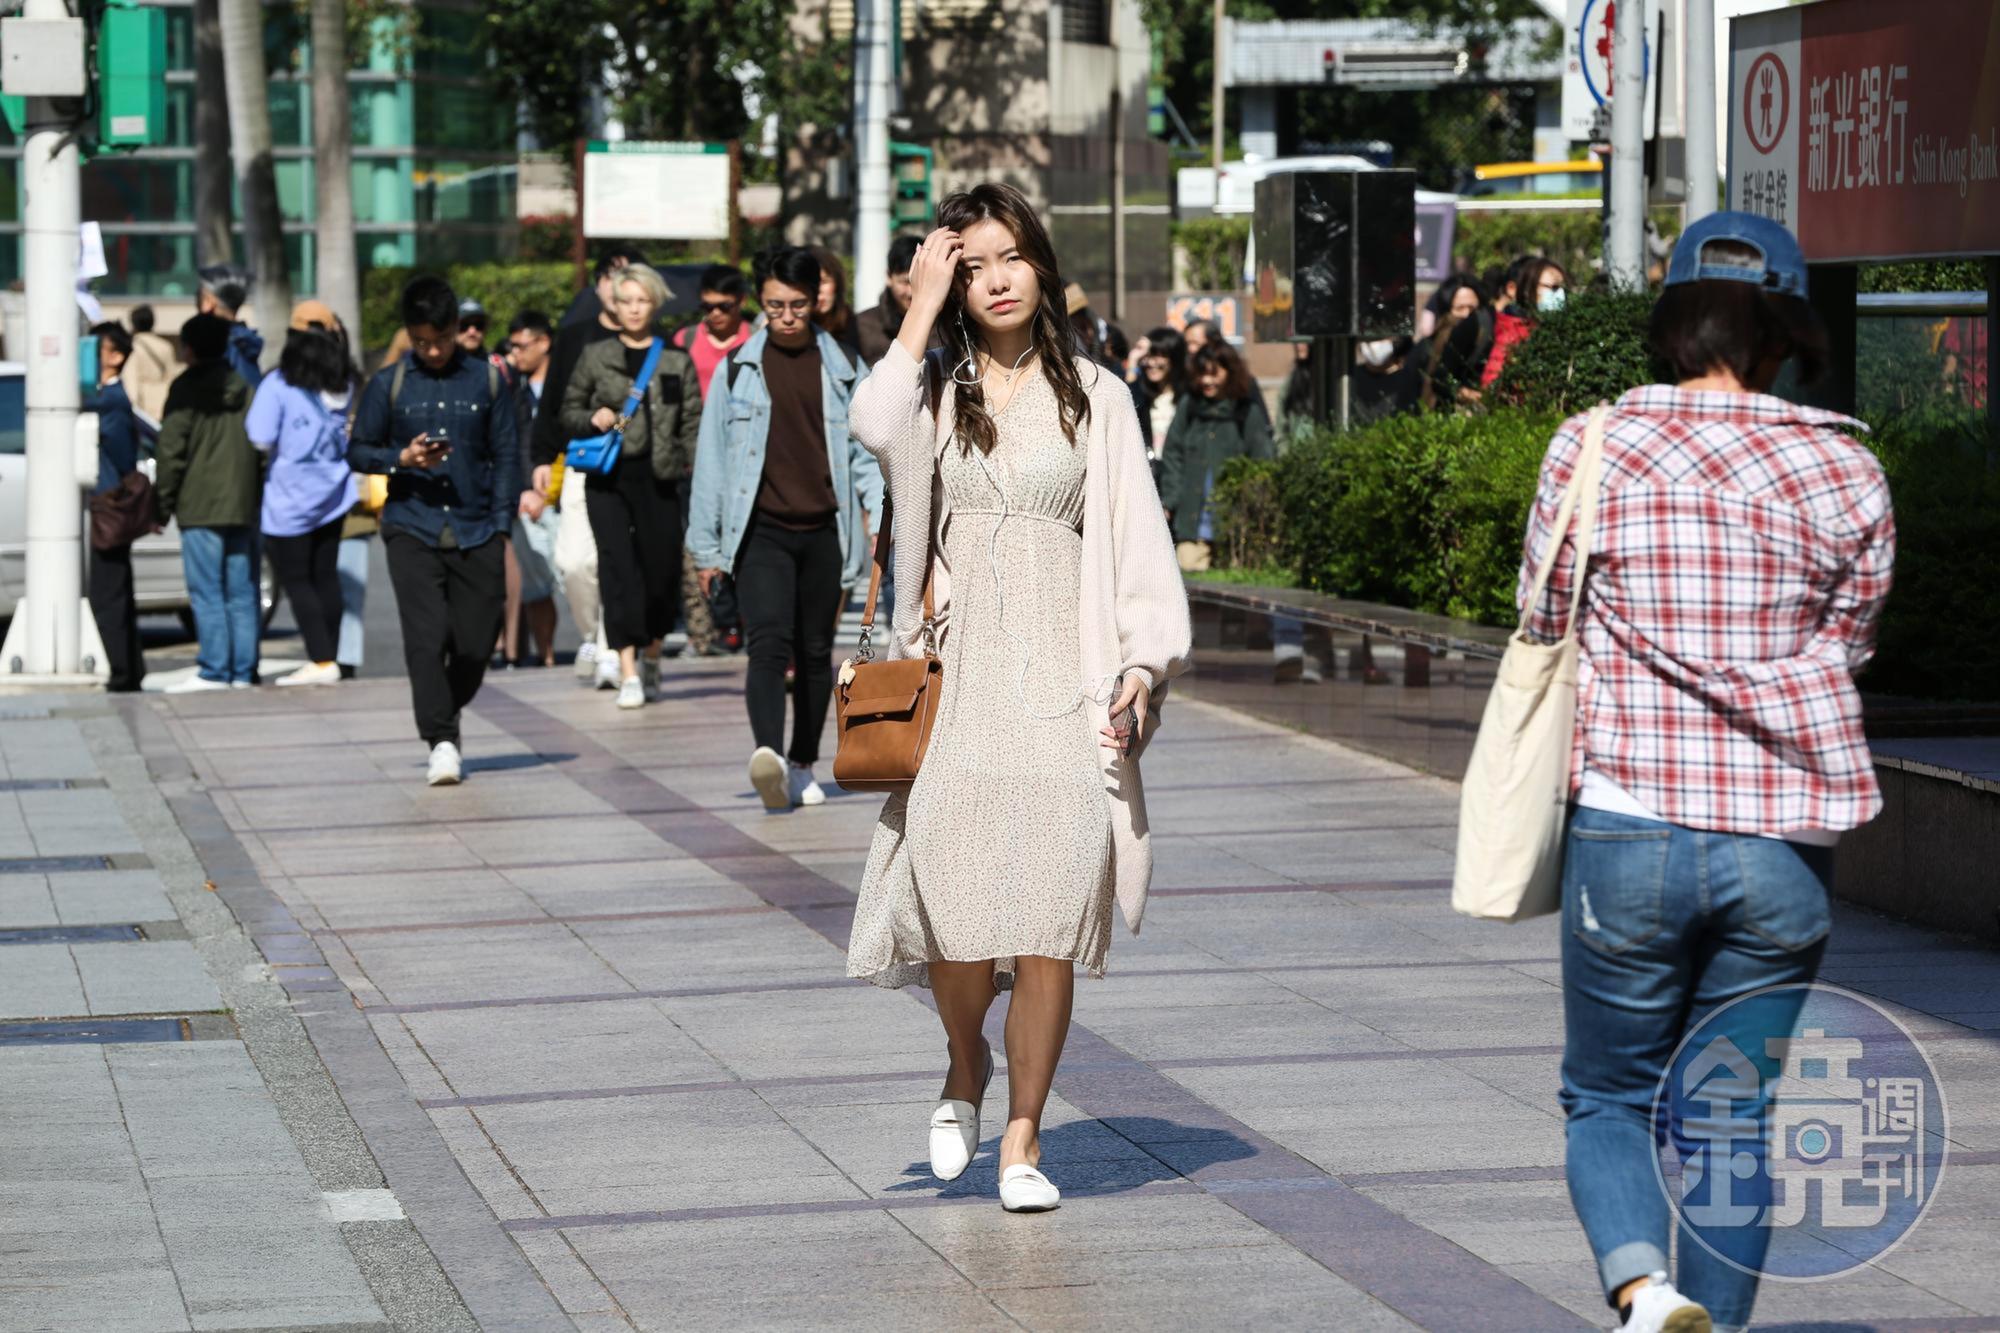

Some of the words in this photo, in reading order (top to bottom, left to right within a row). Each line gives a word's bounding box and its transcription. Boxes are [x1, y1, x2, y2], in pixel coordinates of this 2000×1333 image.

[1807, 64, 1909, 192] 新光銀行
[1912, 133, 1937, 185] Shin
[1939, 135, 1968, 198] Kong
[1970, 126, 1998, 181] Bank
